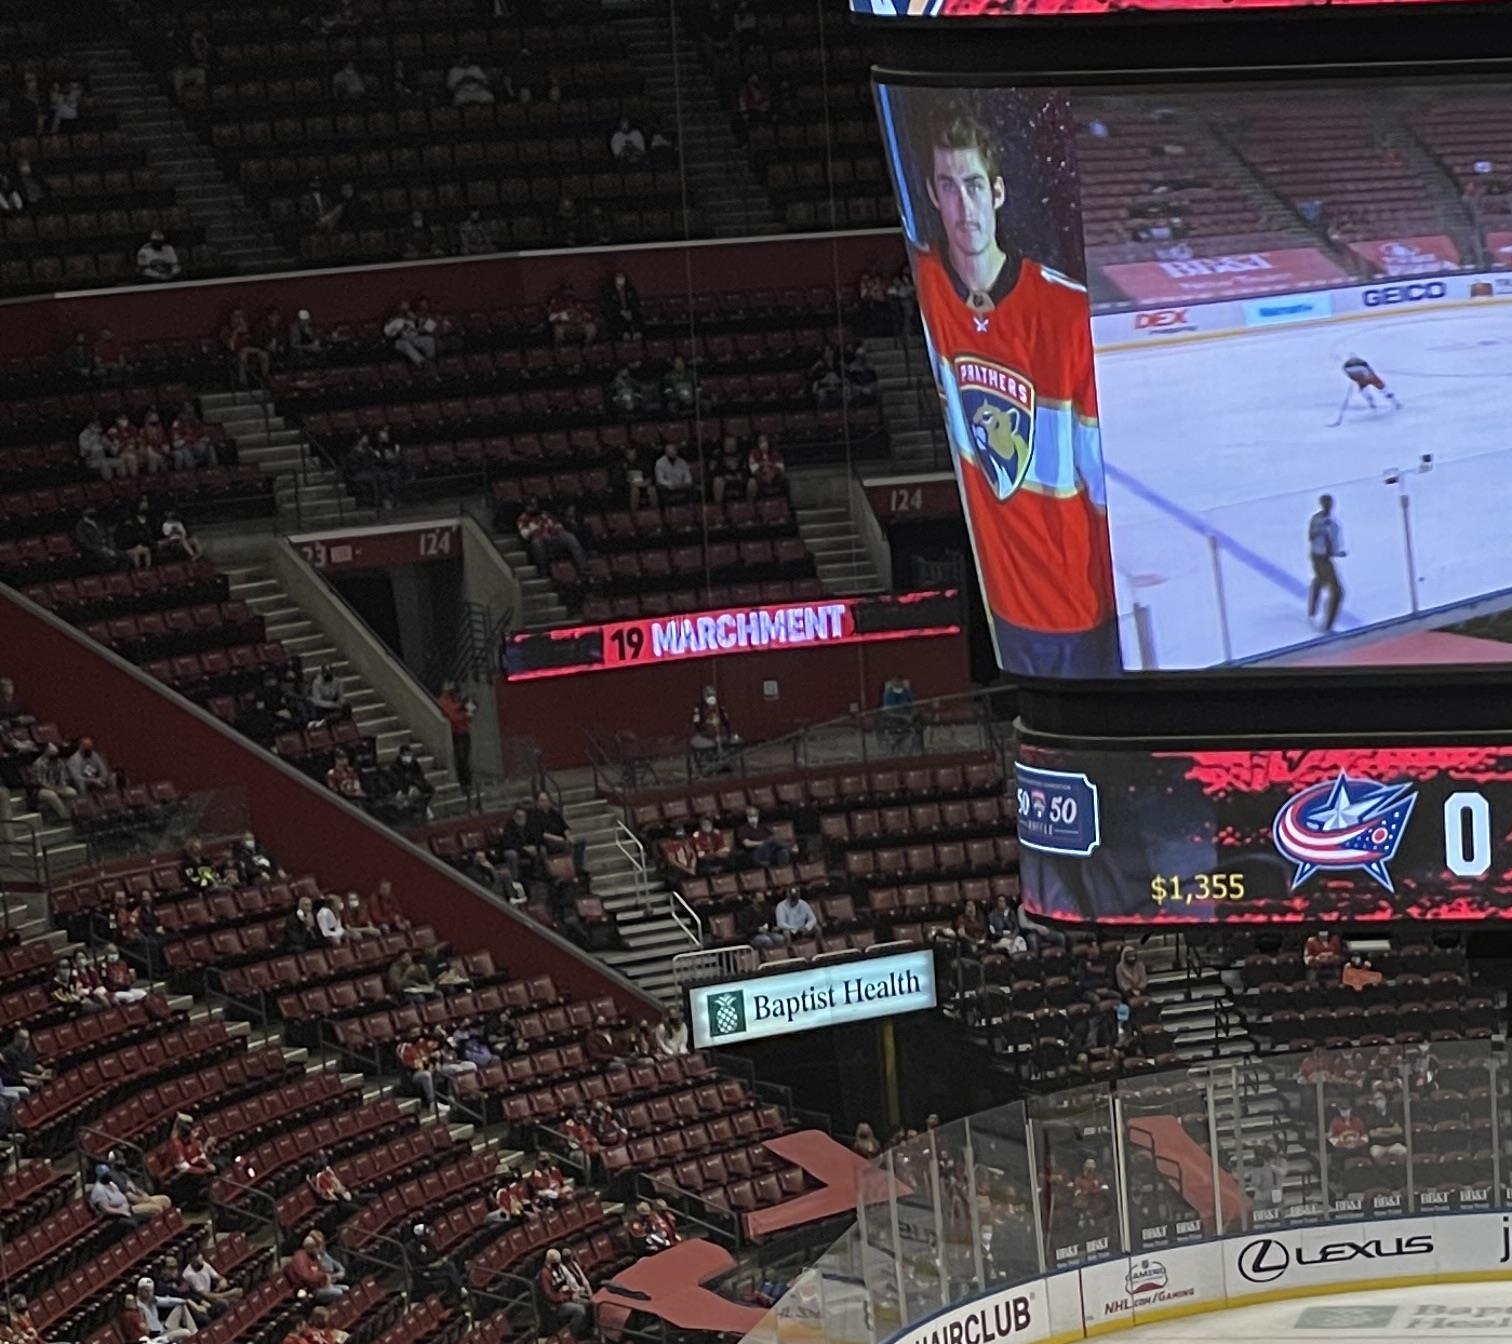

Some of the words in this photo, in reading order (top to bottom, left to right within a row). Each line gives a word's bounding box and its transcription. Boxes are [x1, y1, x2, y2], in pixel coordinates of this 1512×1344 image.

[1363, 281, 1447, 307] GEICO
[1135, 309, 1188, 329] DEX
[960, 363, 1028, 404] PANTHERS
[890, 487, 924, 512] 124
[610, 626, 645, 661] 19
[651, 603, 846, 657] MARCHMENT
[1049, 796, 1078, 825] 50
[1444, 791, 1492, 876] 0
[1150, 873, 1246, 901] $1,355
[753, 984, 836, 1022] Baptist
[844, 968, 922, 1005] Health
[1296, 1235, 1435, 1265] LEXUS
